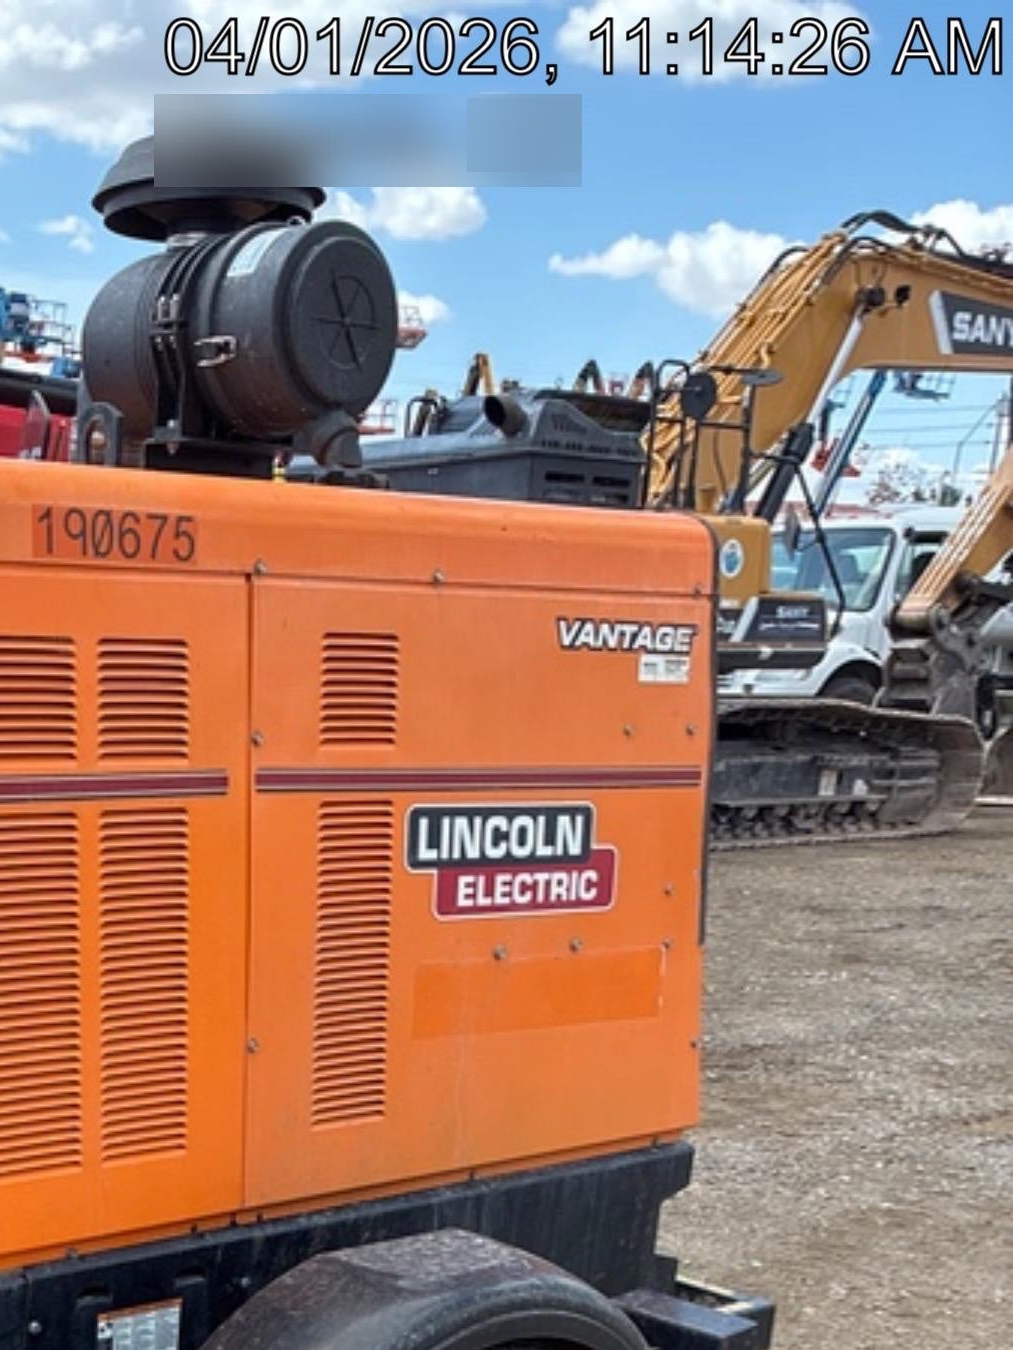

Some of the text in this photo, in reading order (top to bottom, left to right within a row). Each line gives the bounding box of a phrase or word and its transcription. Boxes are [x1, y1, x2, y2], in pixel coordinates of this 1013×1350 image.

[37, 505, 196, 562] 190675
[557, 617, 697, 653] VANTAGE
[417, 815, 585, 862] LINCOLN
[456, 869, 599, 908] ELECTRIC
